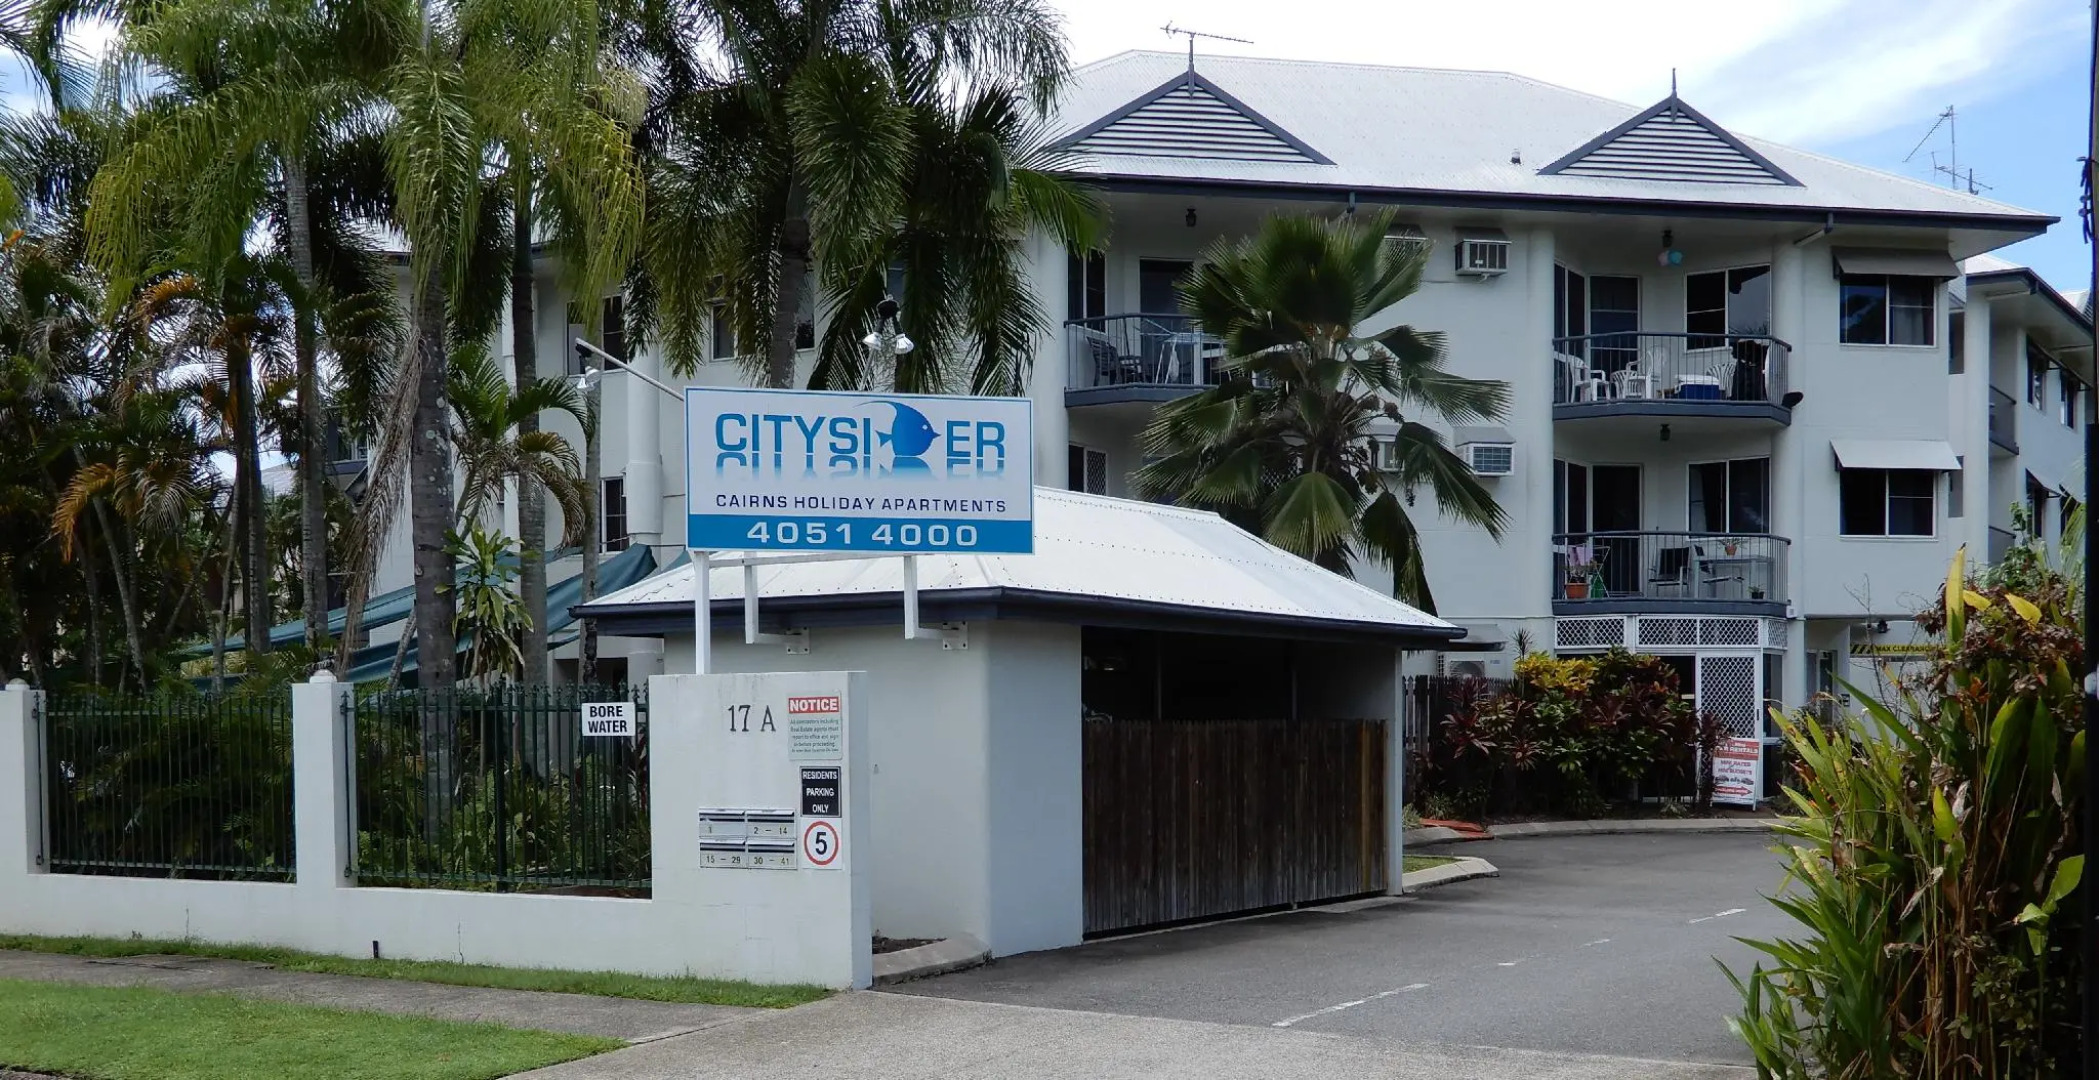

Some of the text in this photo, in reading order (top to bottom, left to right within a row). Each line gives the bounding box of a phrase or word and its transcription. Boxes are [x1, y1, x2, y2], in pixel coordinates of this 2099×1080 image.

[716, 494, 1006, 513] CAIRNS HOLIDAY APARTMENTS
[747, 521, 978, 547] 4051 4000
[790, 699, 838, 711] NOTICE
[590, 705, 623, 718] BORE
[728, 705, 776, 732] 17 A
[588, 720, 627, 733] WATER
[802, 771, 838, 780] RESIDENTS
[806, 787, 835, 797] PARKING
[812, 804, 829, 813] ONLY
[753, 826, 759, 835] 2
[779, 826, 788, 835] 14
[815, 831, 828, 855] 5
[706, 856, 715, 864] 15
[731, 856, 741, 864] 29
[753, 857, 764, 865] 30
[780, 857, 790, 865] 41
